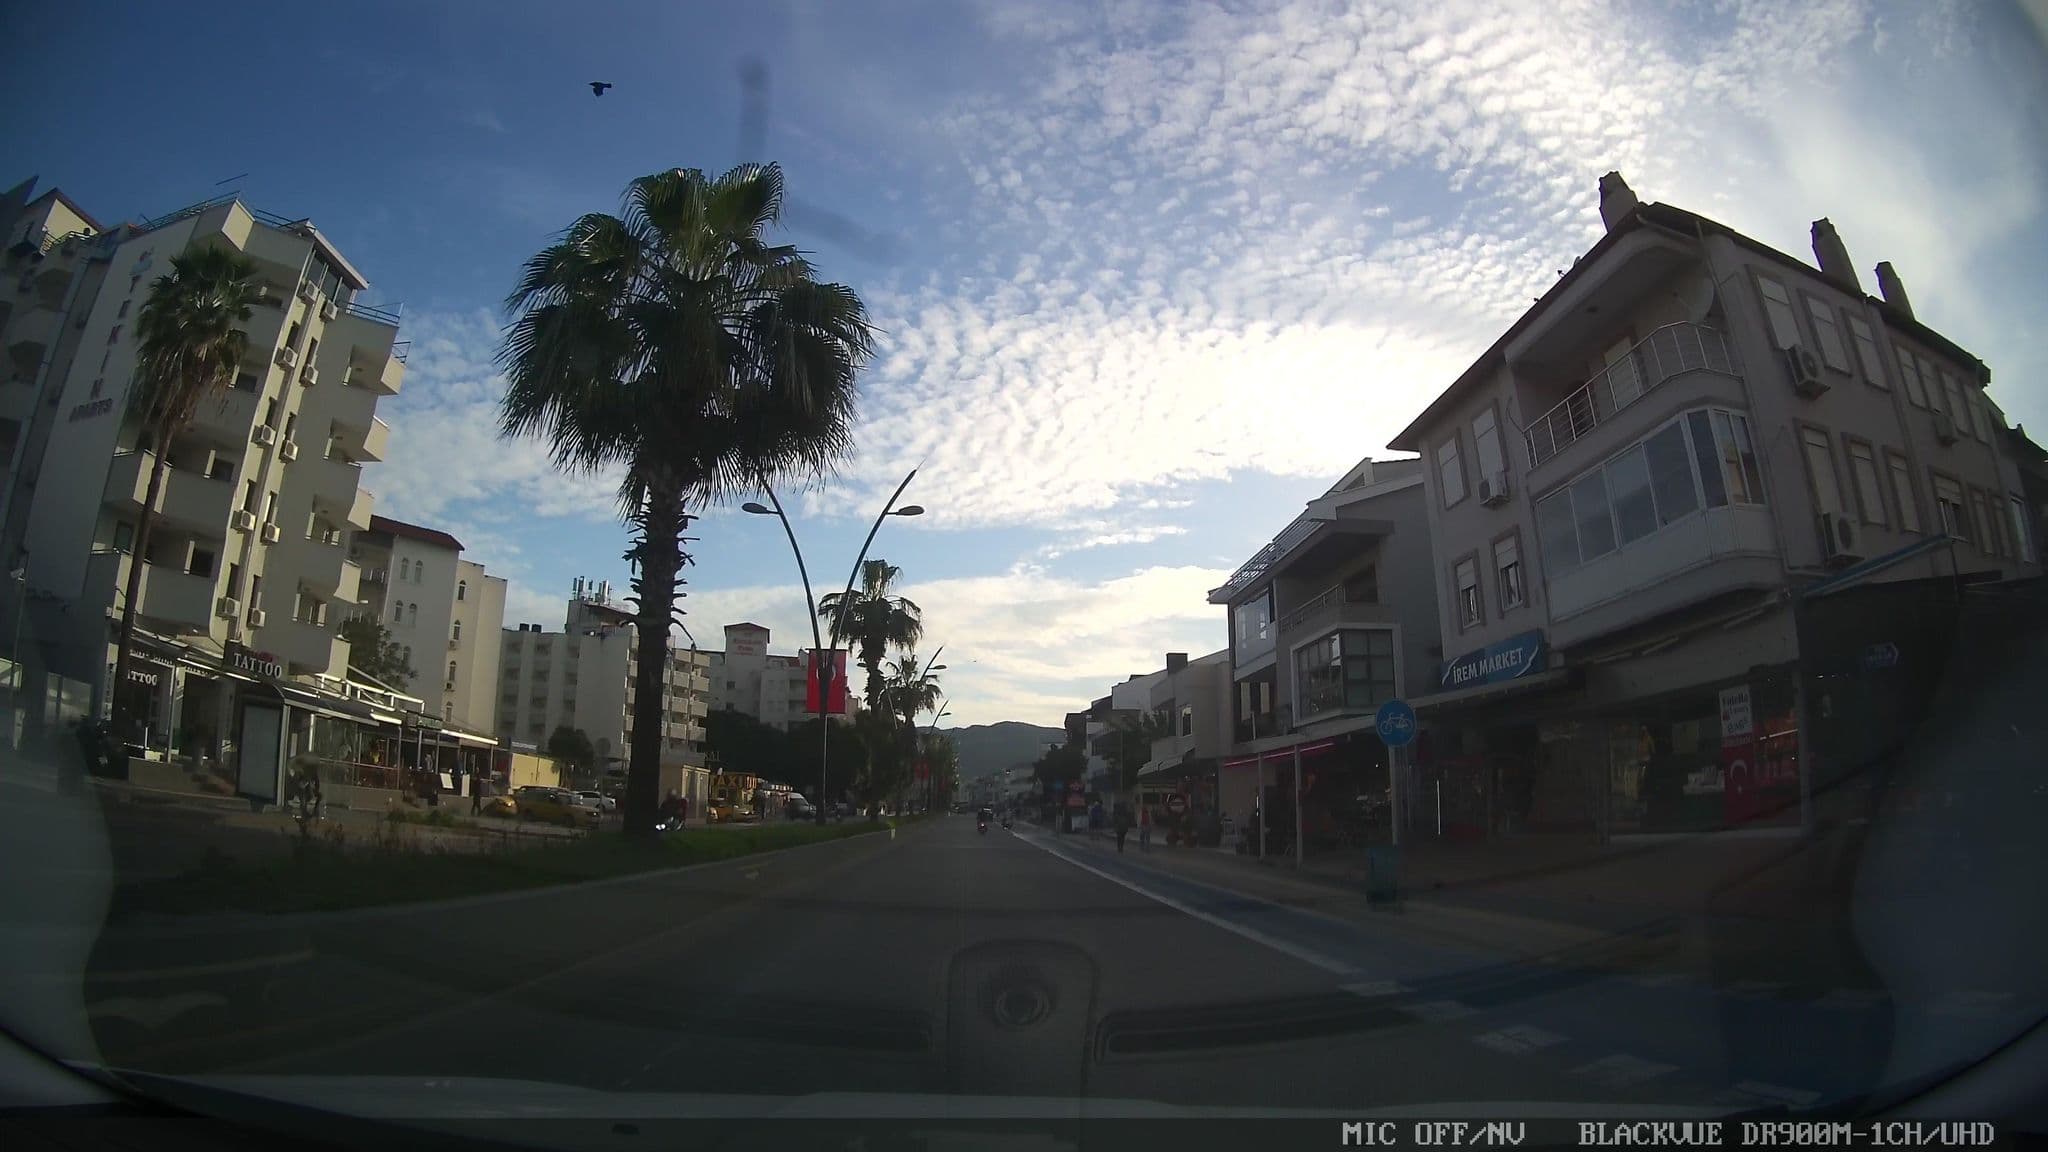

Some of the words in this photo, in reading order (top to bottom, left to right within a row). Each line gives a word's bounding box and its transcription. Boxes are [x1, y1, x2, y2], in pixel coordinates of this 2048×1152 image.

[233, 651, 282, 679] TATTOO
[1453, 661, 1478, 684] İREM
[1478, 647, 1524, 676] MARKET
